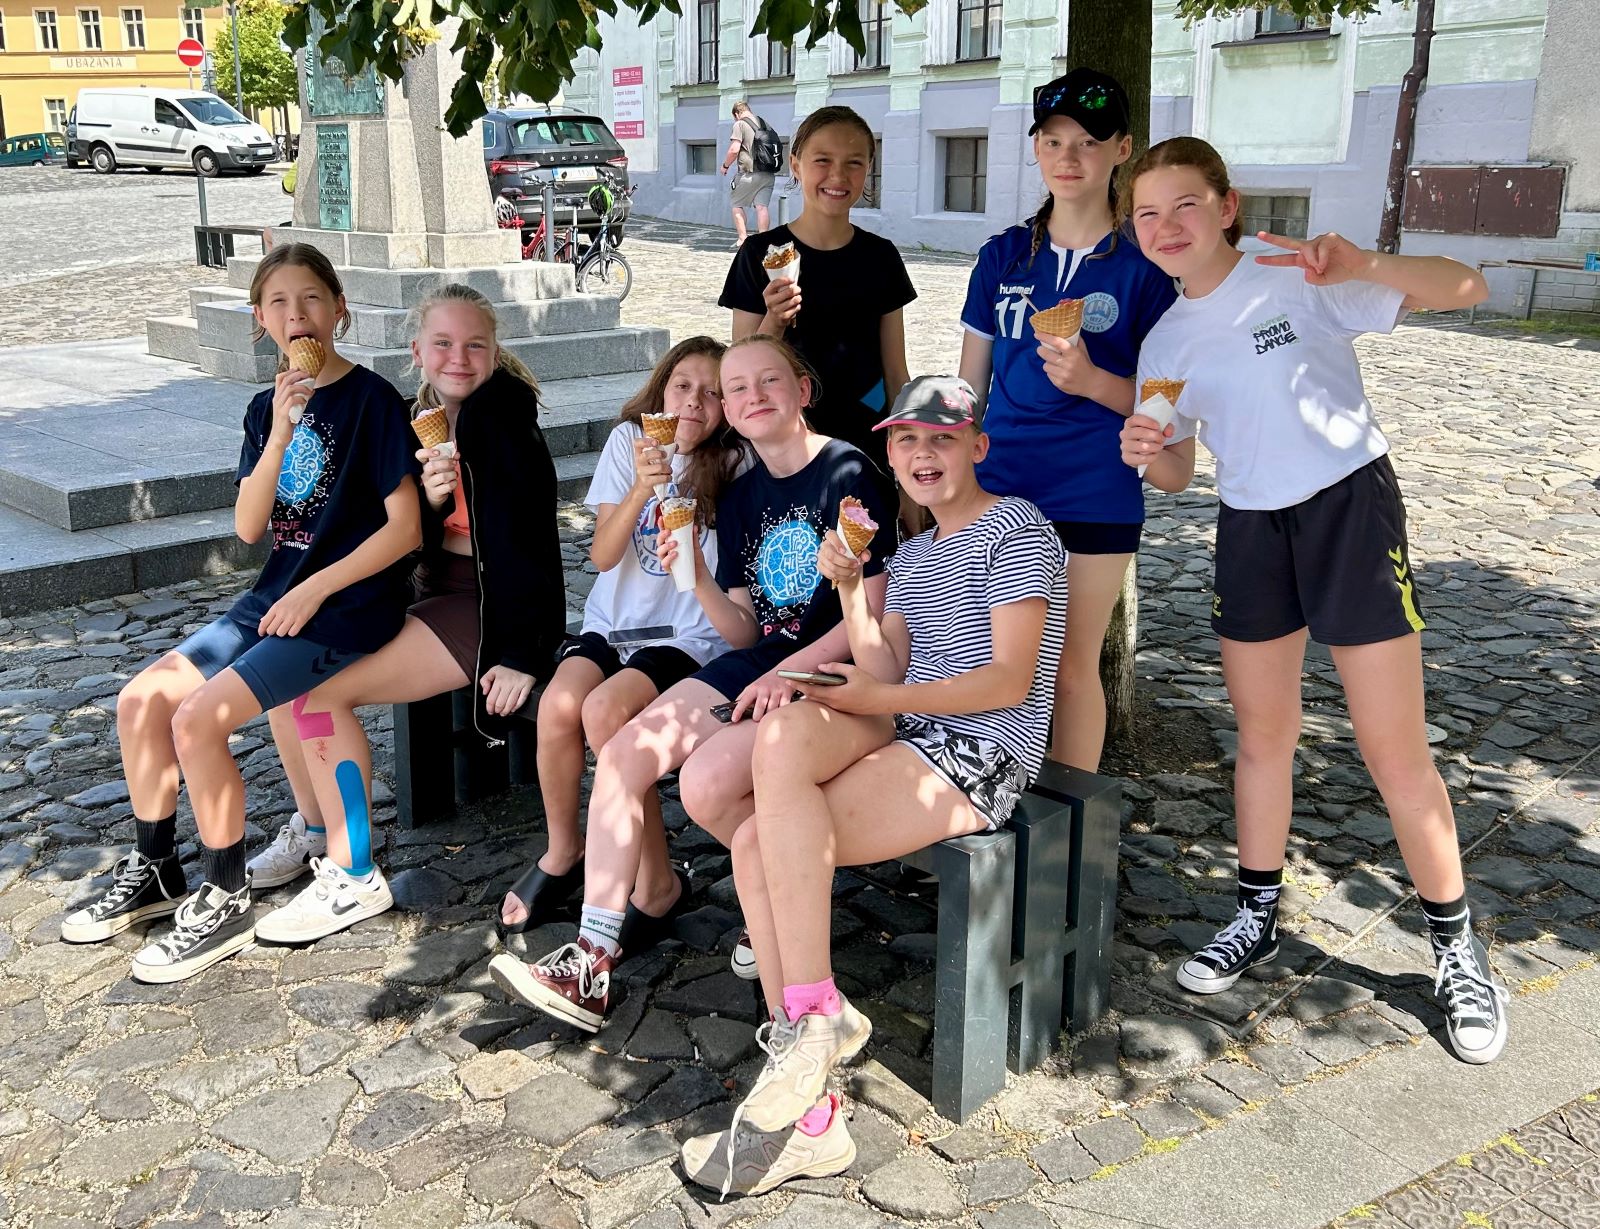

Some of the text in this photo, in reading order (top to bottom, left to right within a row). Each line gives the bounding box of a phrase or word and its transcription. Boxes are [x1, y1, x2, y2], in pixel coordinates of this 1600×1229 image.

[999, 282, 1035, 295] hummel
[995, 296, 1028, 340] 11
[1252, 320, 1291, 343] PROMO
[1255, 330, 1297, 355] DANCE
[1259, 890, 1278, 899] NIKE
